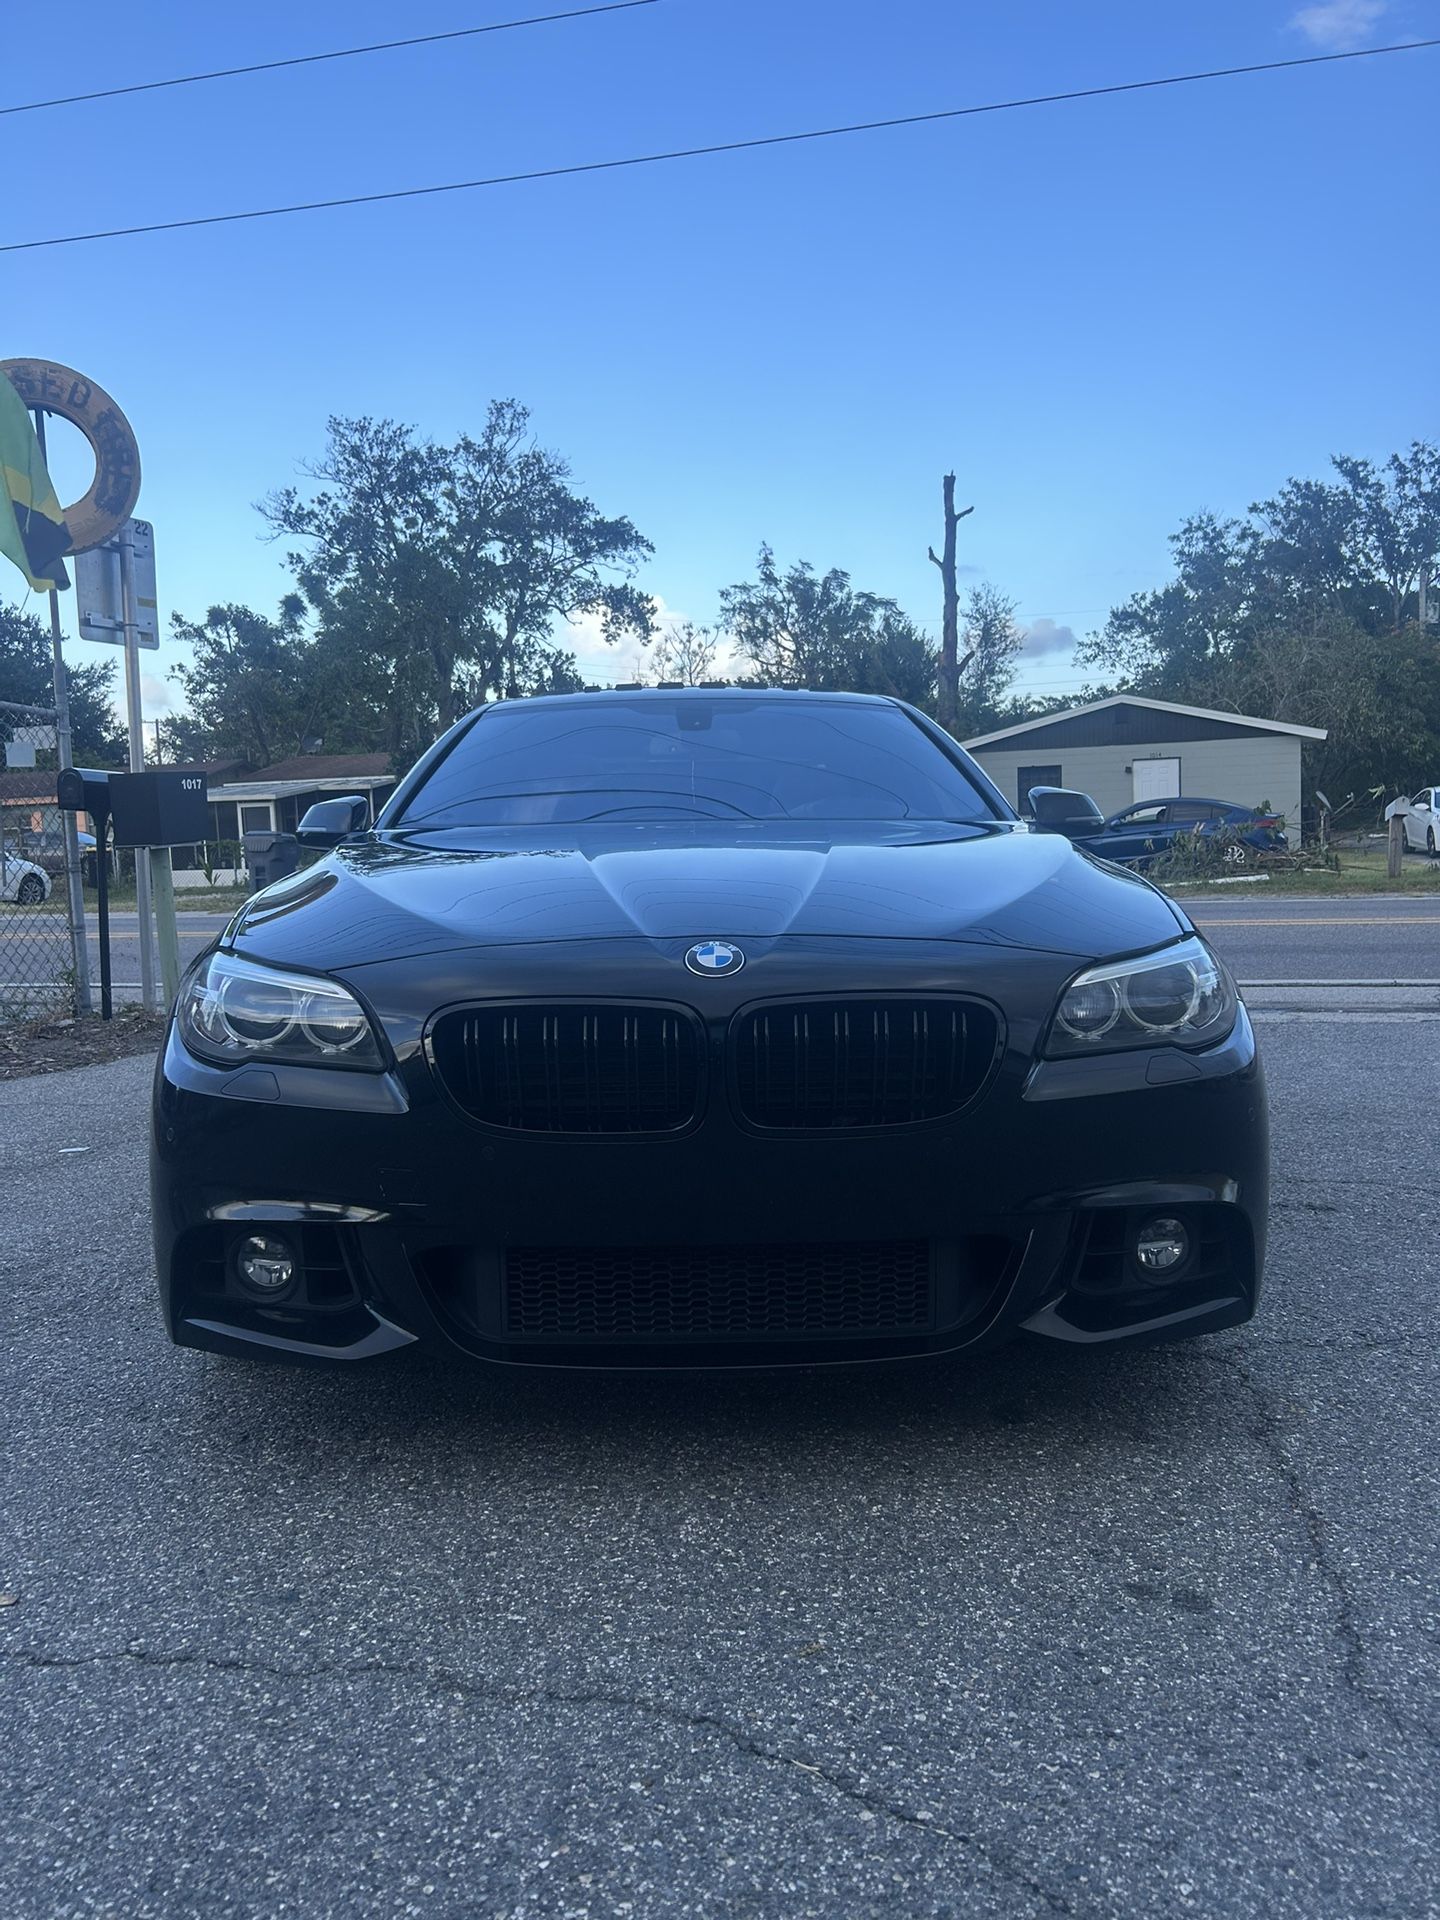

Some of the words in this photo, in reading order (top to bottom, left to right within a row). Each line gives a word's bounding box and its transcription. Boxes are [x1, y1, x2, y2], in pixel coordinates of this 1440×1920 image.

[135, 520, 148, 536] 22
[181, 779, 202, 790] 1017
[692, 941, 739, 952] BMW
